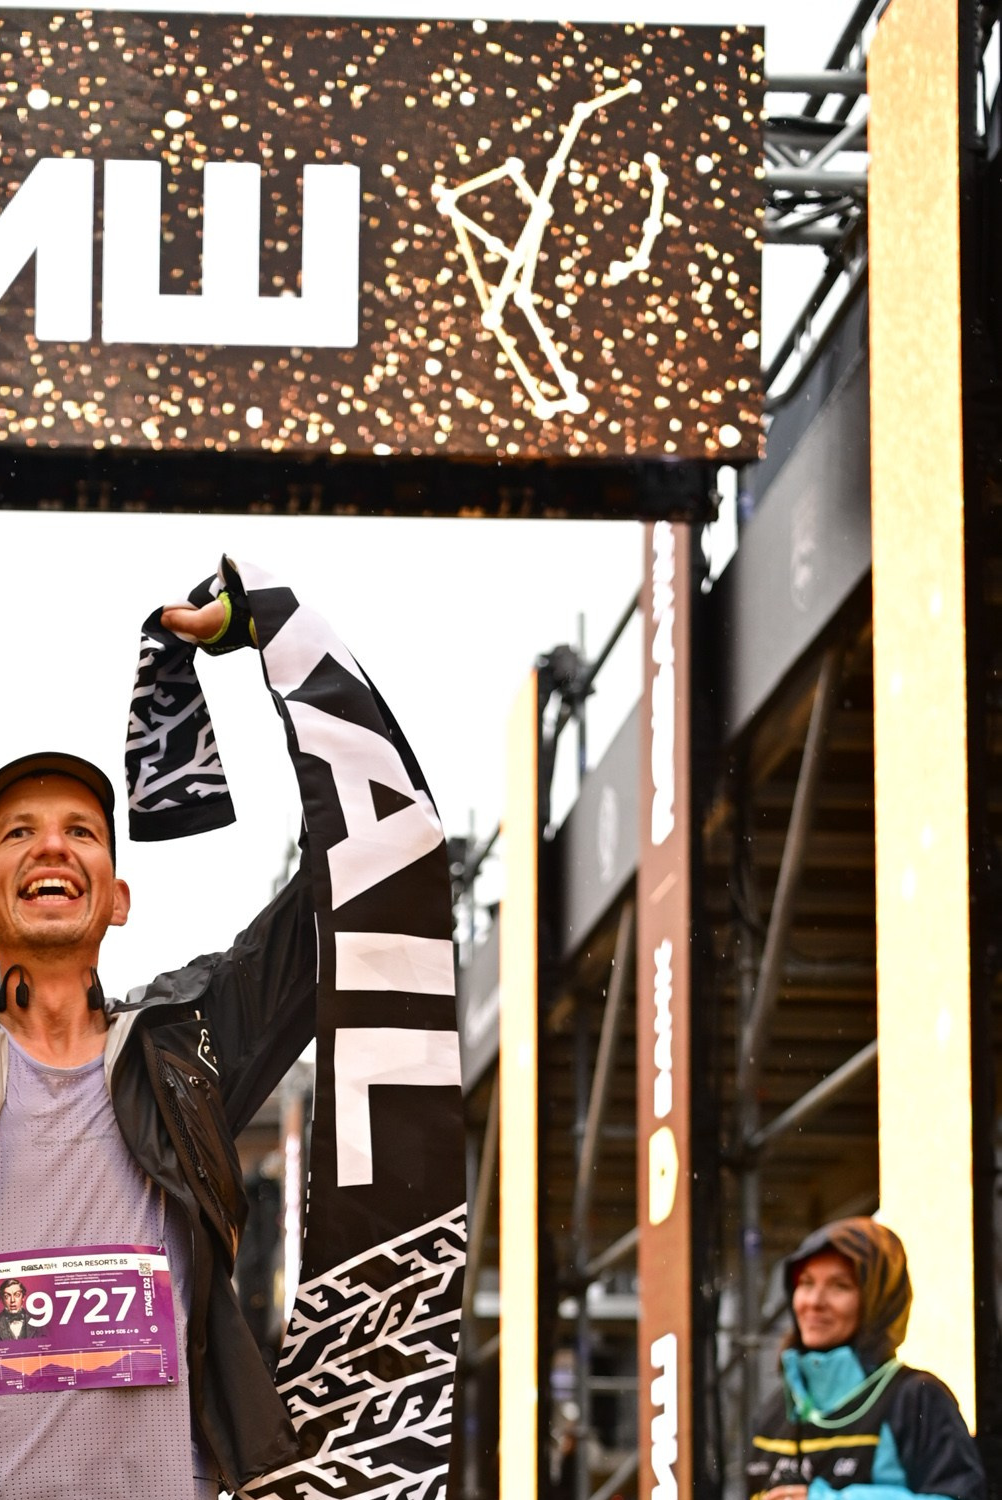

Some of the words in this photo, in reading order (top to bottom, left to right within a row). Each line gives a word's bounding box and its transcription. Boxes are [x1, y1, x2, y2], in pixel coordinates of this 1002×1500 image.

[84, 1259, 118, 1267] RESORTS
[143, 1277, 151, 1289] D2
[26, 1287, 137, 1328] 9727
[144, 1289, 153, 1317] STAGE
